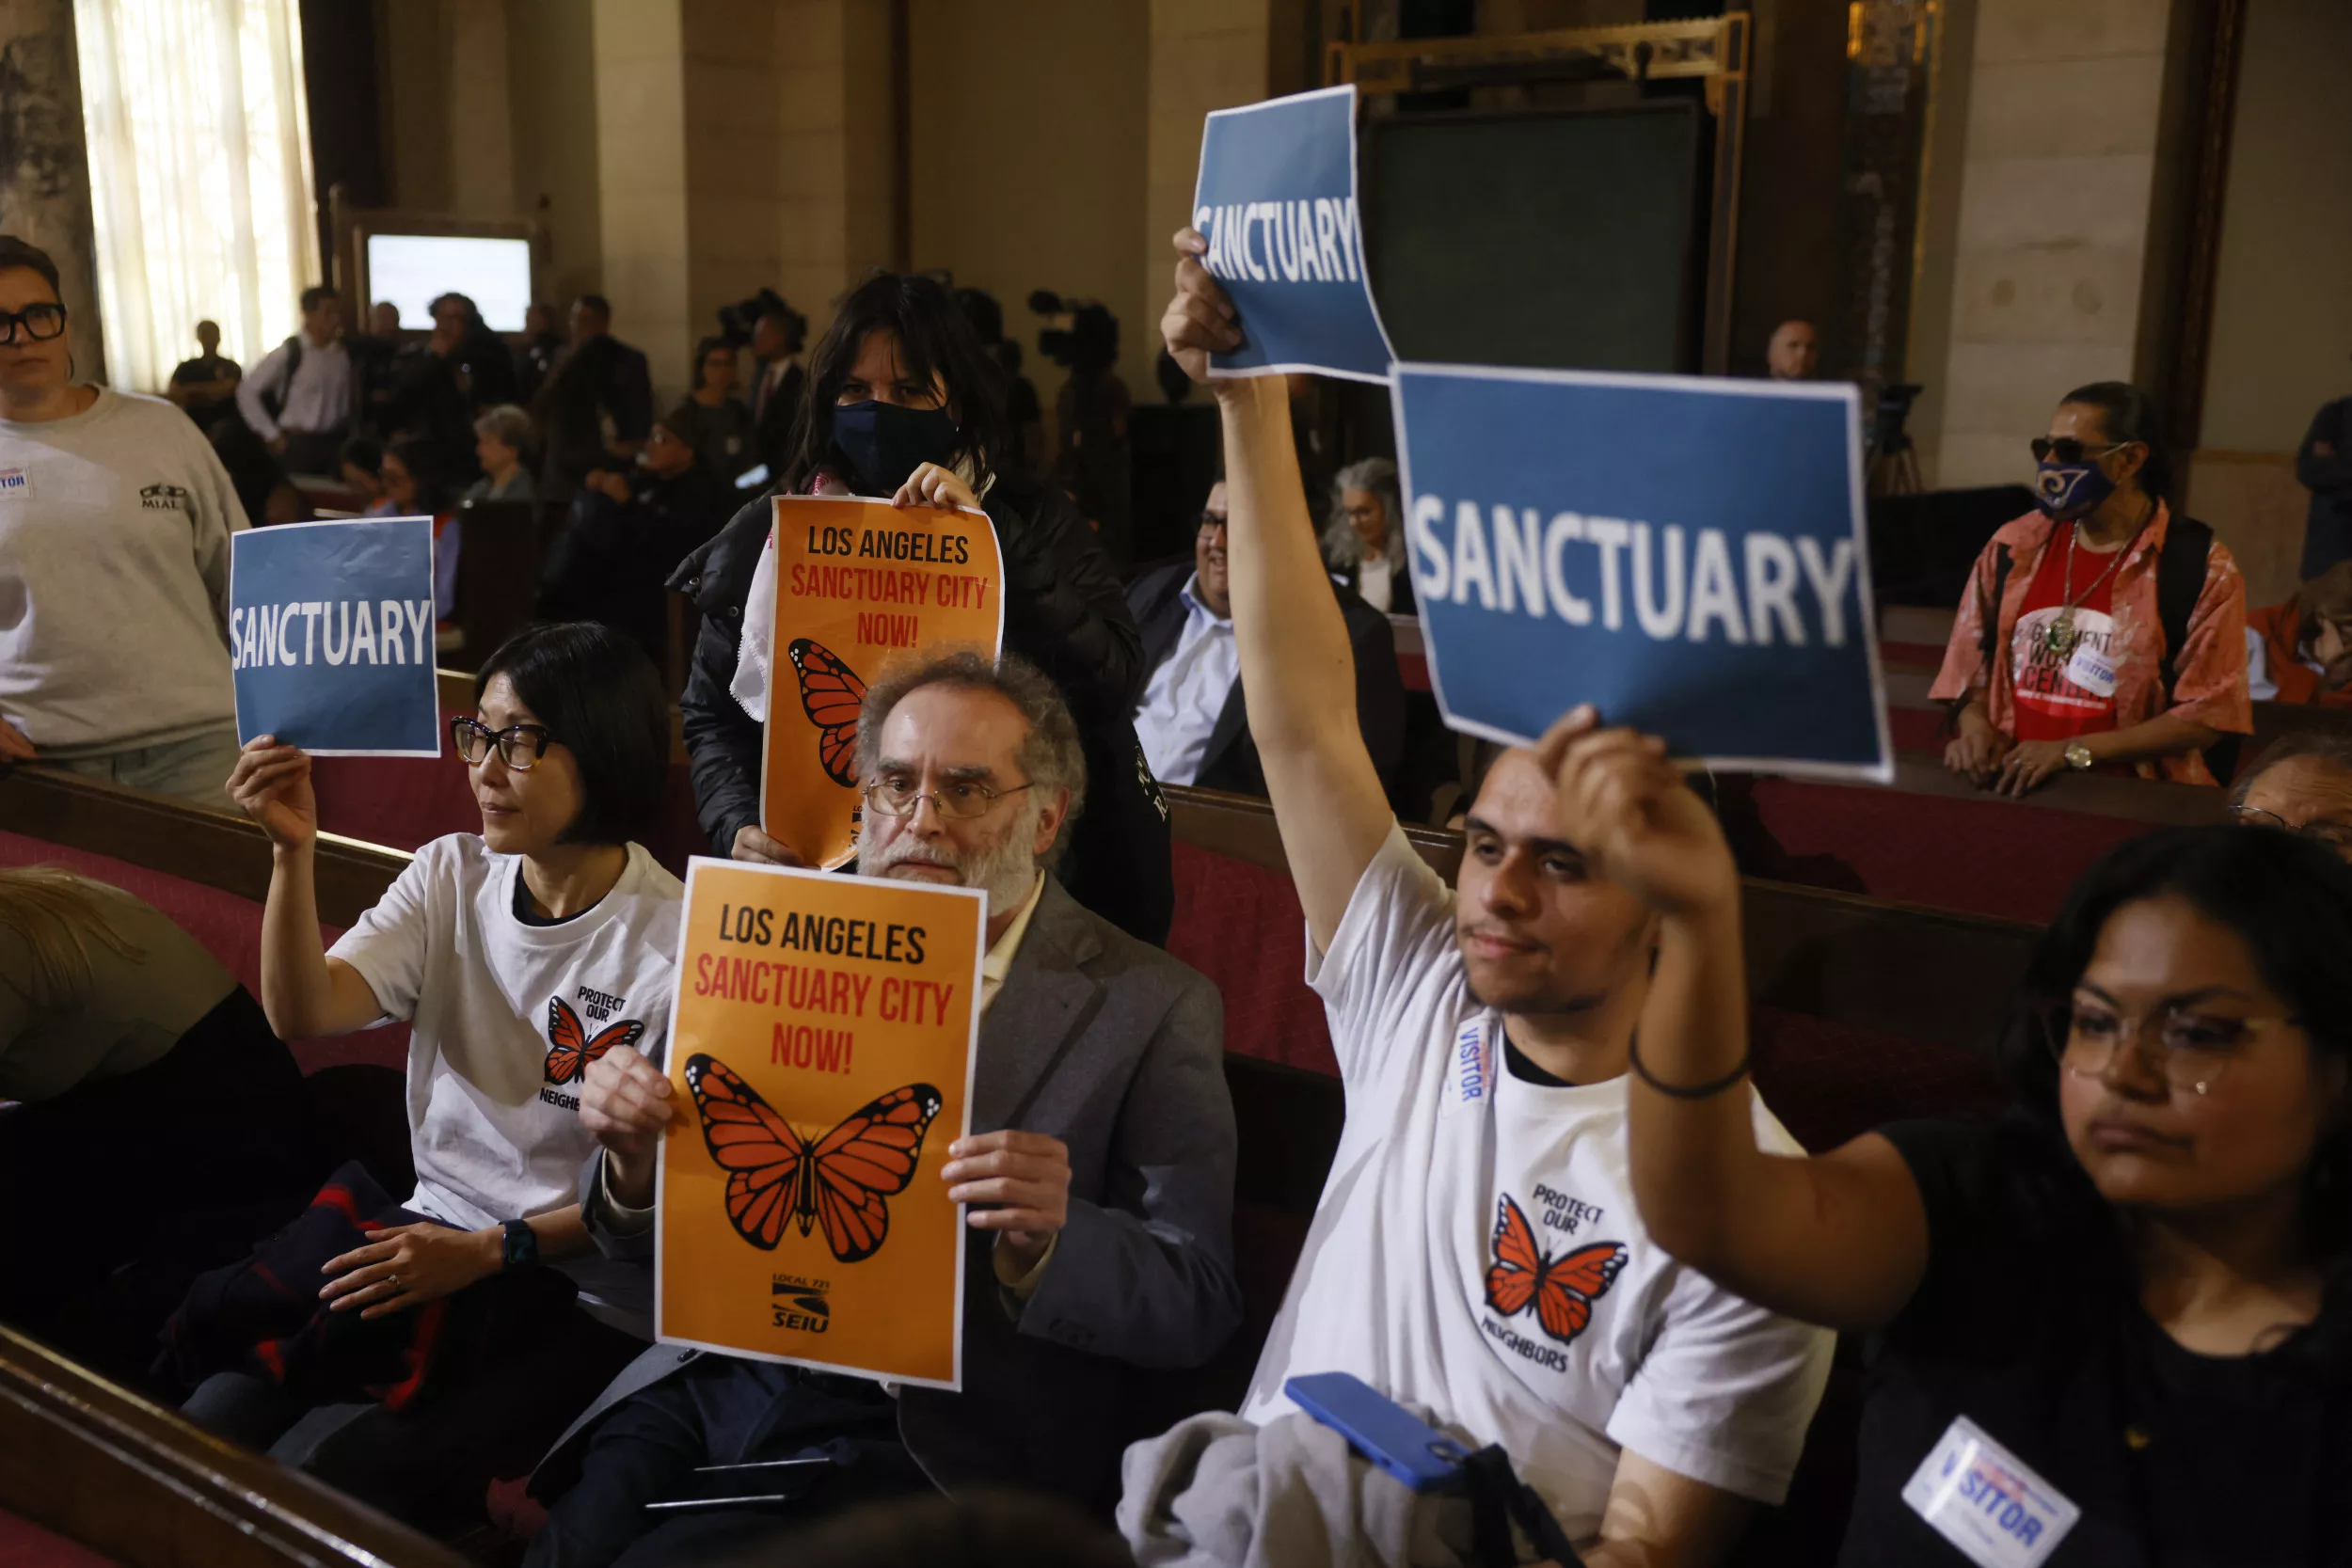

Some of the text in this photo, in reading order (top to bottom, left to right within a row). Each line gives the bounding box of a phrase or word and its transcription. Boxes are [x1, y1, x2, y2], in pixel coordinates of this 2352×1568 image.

[808, 526, 969, 564] LOS ANGELES
[791, 563, 988, 610] SANCTUARY CITY
[1413, 494, 1854, 648] SANCTUARY
[231, 600, 431, 671] SANCTUARY
[857, 611, 918, 648] NOW!
[720, 904, 927, 965] LOS ANGELES
[577, 985, 627, 1012] PROTECT
[694, 952, 955, 1027] SANCTUARY CITY
[585, 1004, 610, 1022] OUR
[771, 1022, 854, 1075] NOW!
[1459, 1026, 1483, 1102] VISITOR
[1532, 1182, 1605, 1224] PROTECT
[1543, 1209, 1580, 1236] OUR
[771, 1273, 831, 1290] LOCAL 721
[771, 1311, 830, 1334] SEIU
